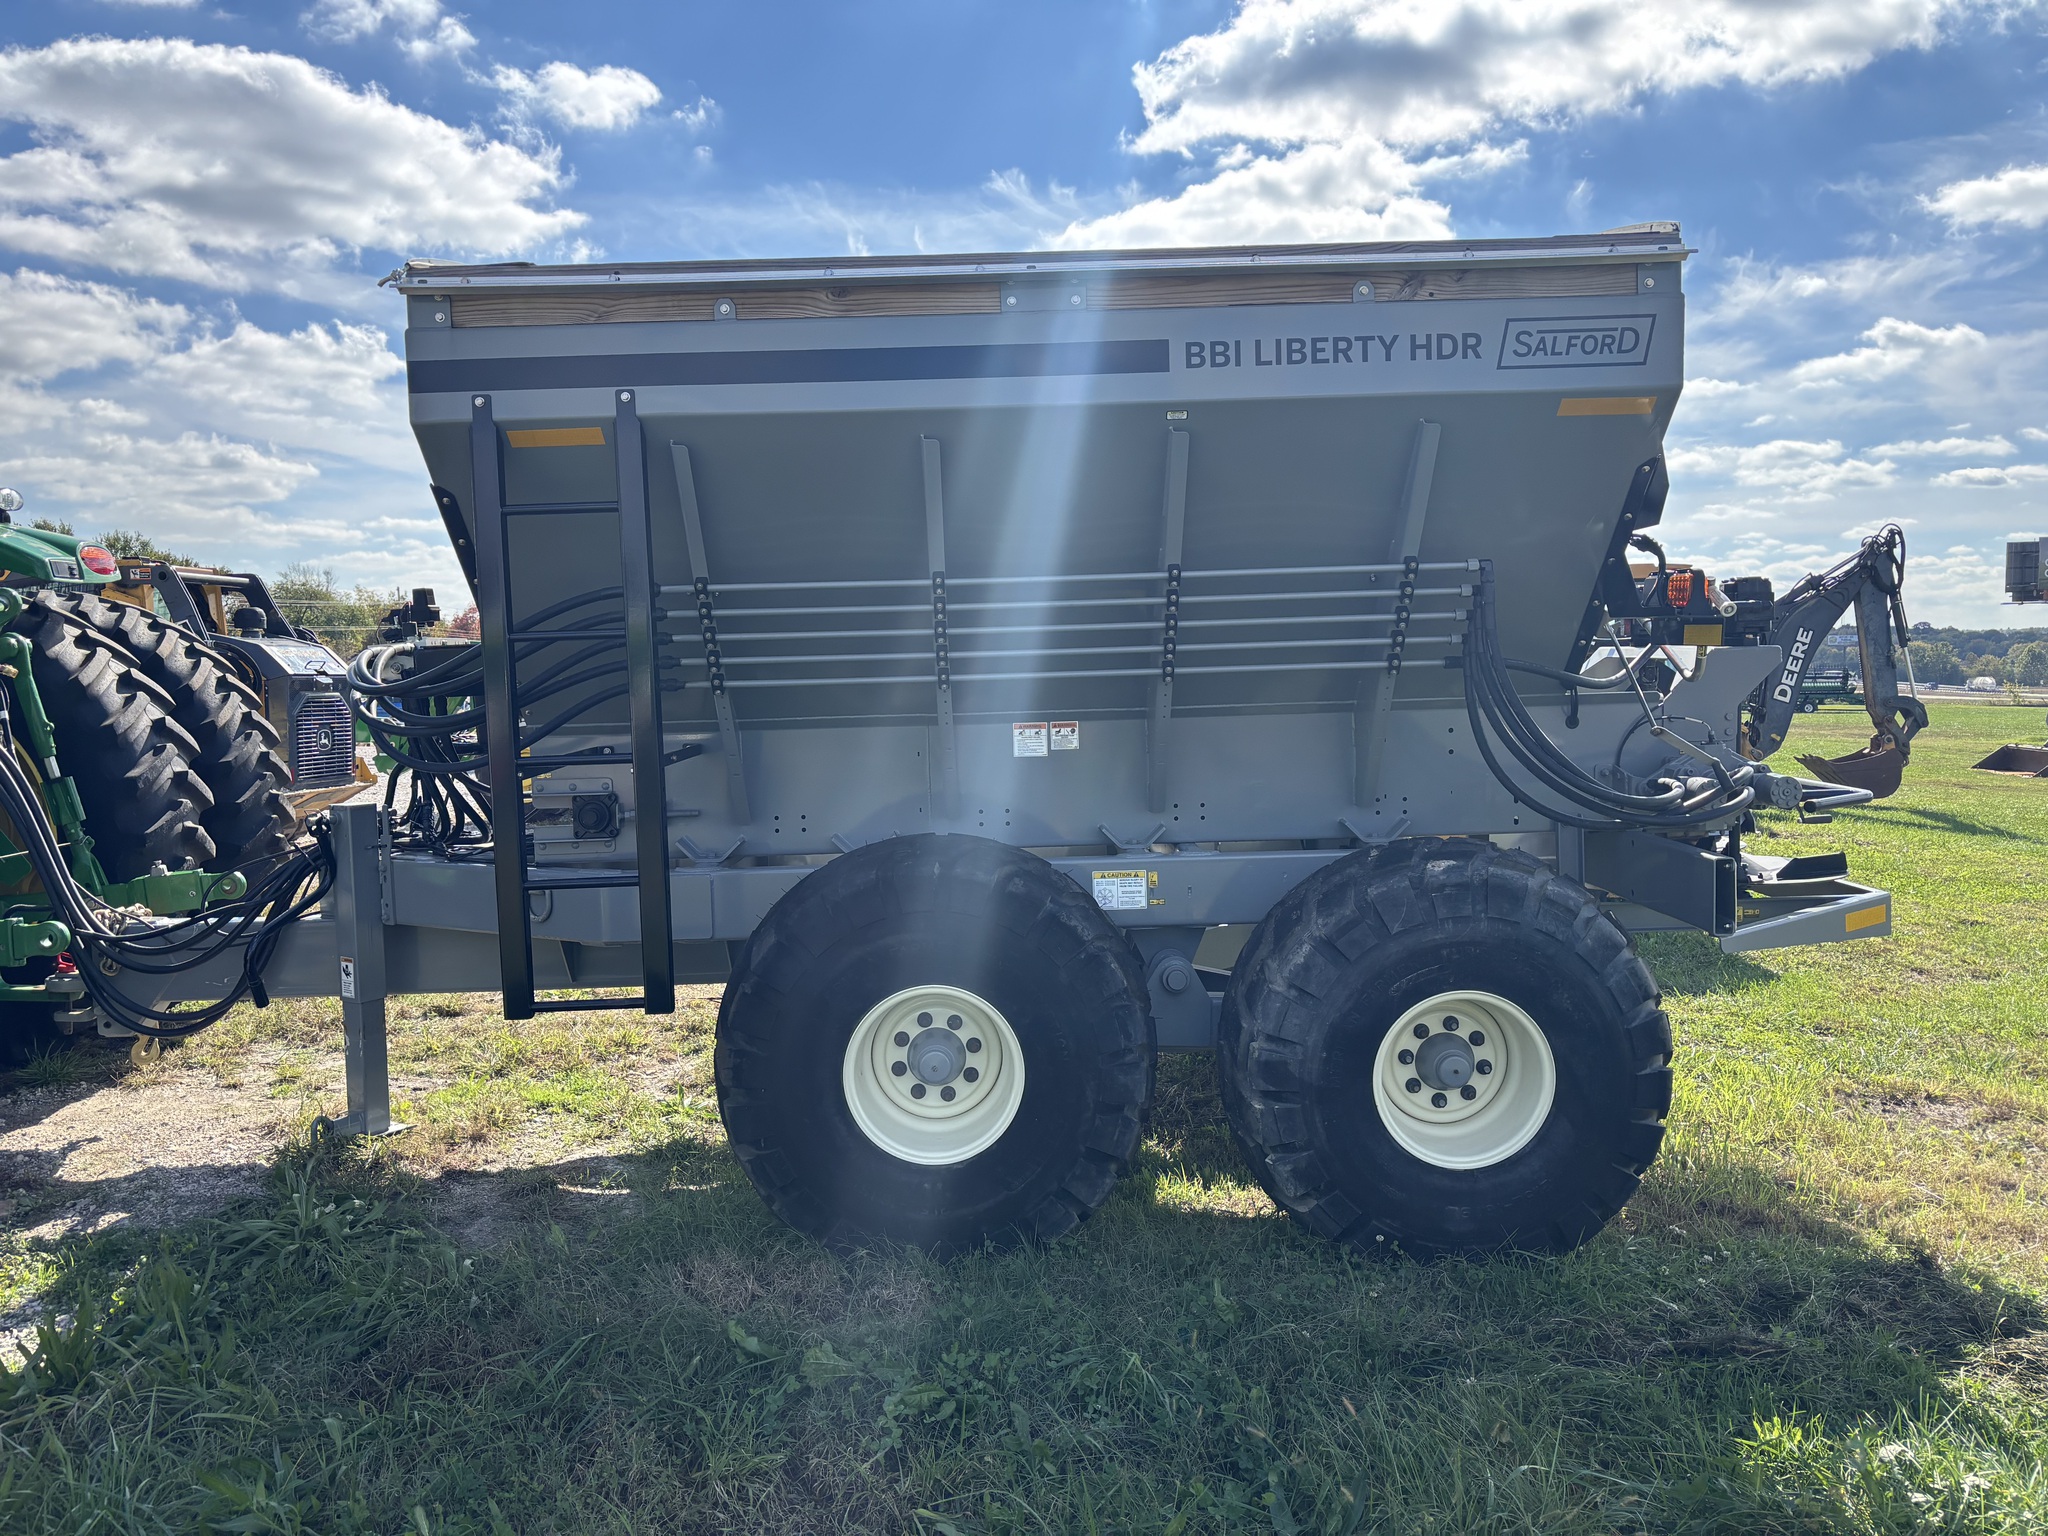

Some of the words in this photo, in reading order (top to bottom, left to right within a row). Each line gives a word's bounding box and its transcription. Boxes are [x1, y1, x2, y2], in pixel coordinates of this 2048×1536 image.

[1185, 340, 1241, 369] BBI
[1254, 334, 1400, 367] LIBERTY
[1409, 332, 1483, 362] HDR
[1512, 326, 1640, 358] SALFORD
[1773, 627, 1814, 704] DEERE
